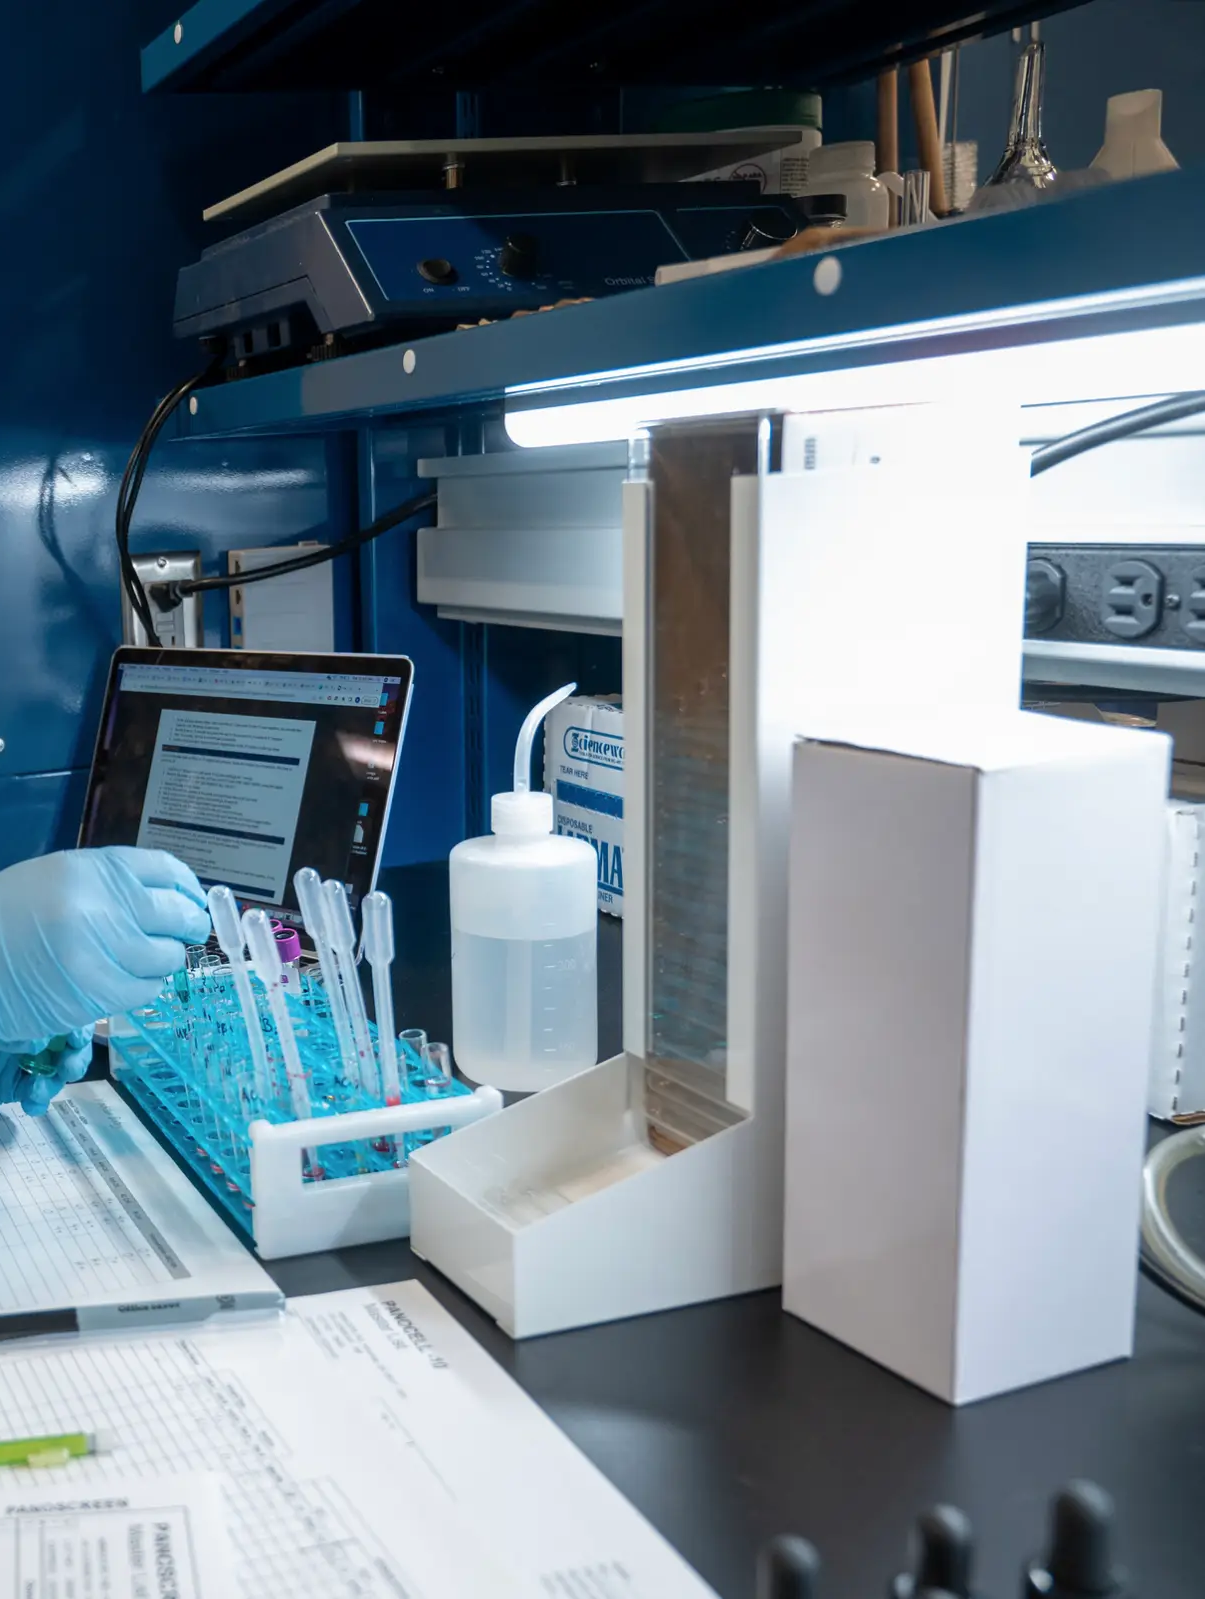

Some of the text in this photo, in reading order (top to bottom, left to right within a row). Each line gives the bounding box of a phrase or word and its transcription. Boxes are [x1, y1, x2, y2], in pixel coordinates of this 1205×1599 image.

[604, 275, 647, 286] Orbital
[557, 814, 593, 834] DISPOSABLE
[381, 1299, 431, 1355] PANOCELL
